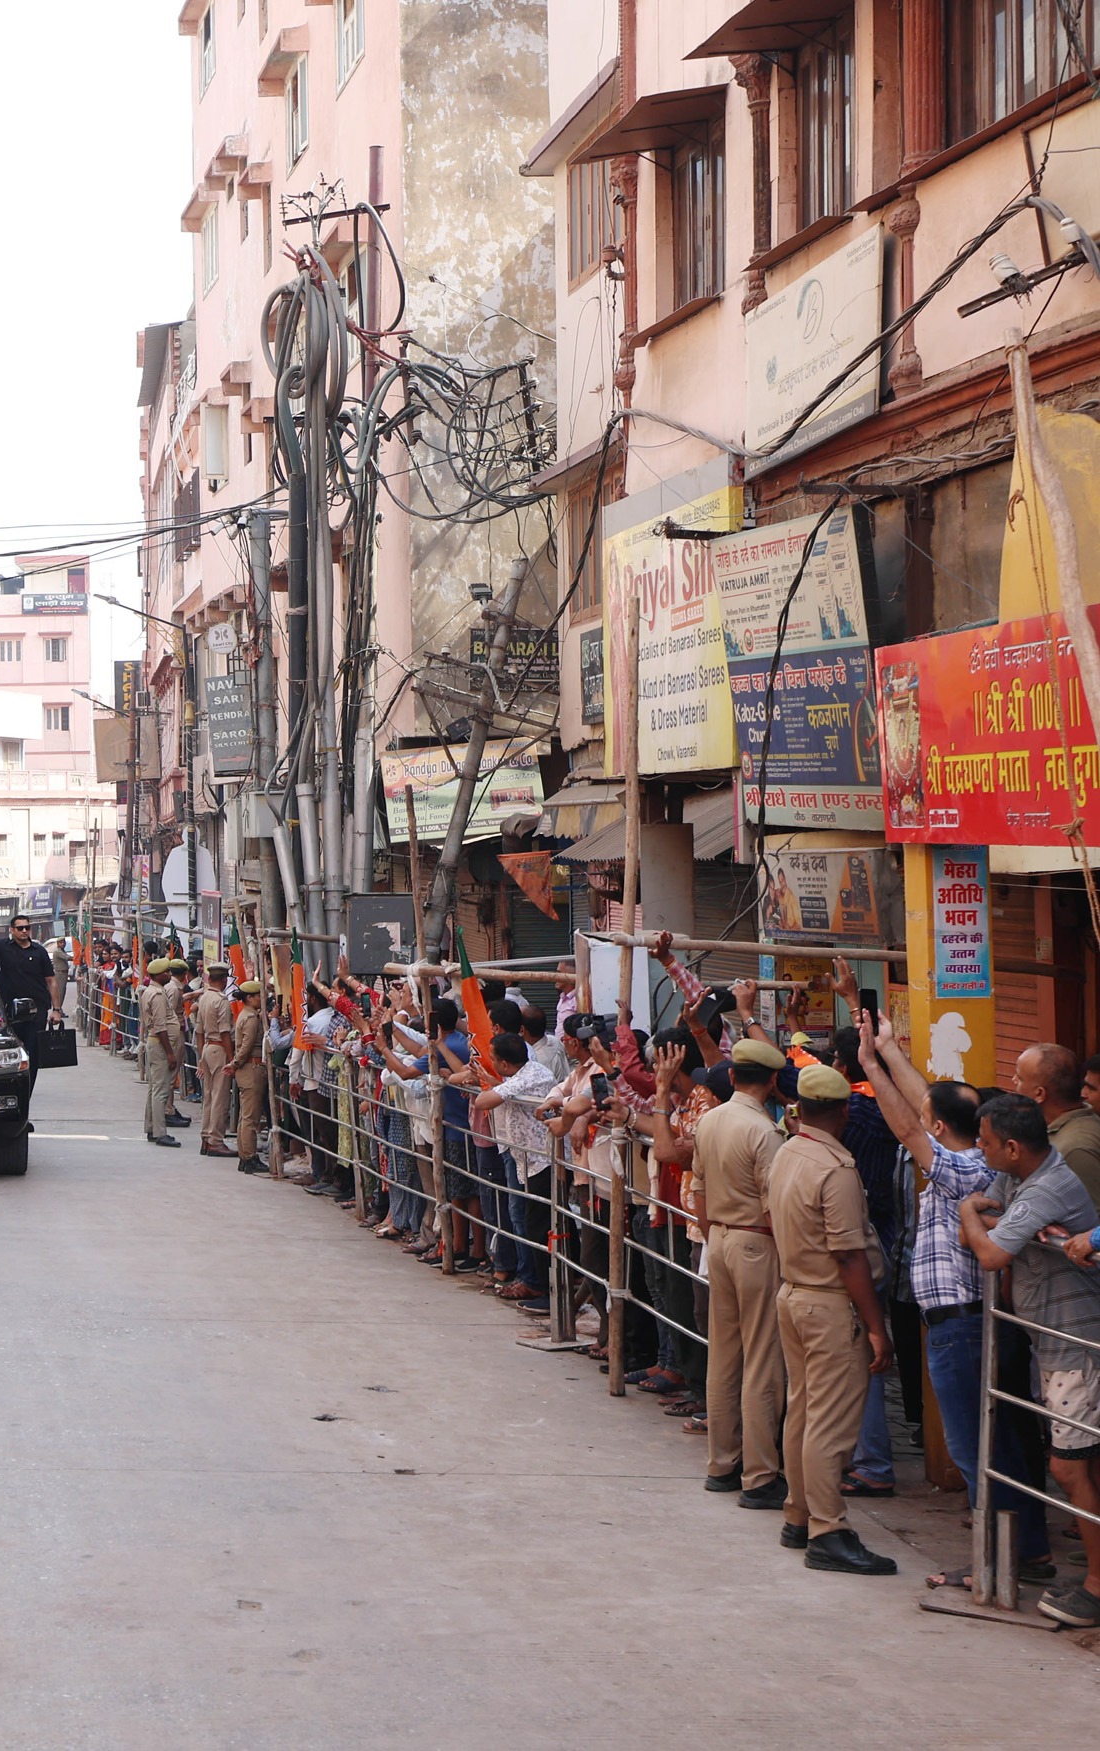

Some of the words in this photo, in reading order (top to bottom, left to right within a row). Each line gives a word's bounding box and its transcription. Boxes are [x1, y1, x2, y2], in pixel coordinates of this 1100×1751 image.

[750, 545, 759, 562] का
[623, 543, 676, 632] Priyal
[719, 576, 749, 593] VATRUJA
[749, 572, 770, 586] AMRIT
[638, 638, 659, 662] ecialist
[660, 636, 668, 655] of
[669, 630, 696, 654] Banarasi
[698, 626, 722, 646] Sarees
[206, 679, 242, 693] NAV
[643, 677, 658, 699] Kind
[659, 673, 667, 695] of
[667, 666, 697, 695] Banarasi
[698, 665, 725, 689] Sarees
[730, 674, 751, 694] कब्ज
[752, 672, 765, 692] का
[784, 662, 806, 690] बिना
[834, 657, 847, 685] के
[210, 710, 251, 721] KENDRA
[651, 709, 657, 732] &
[658, 705, 678, 730] Dress
[678, 699, 708, 727] Material
[733, 701, 781, 724] Kabz-Gne
[985, 680, 1004, 735] श्री
[1007, 677, 1026, 732] श्री
[676, 742, 698, 759] Varanasi
[403, 762, 437, 779] Pandya
[926, 744, 942, 796] श्री
[996, 749, 1031, 793] माता
[1043, 747, 1069, 791] नव
[765, 787, 787, 808] राधे
[789, 792, 817, 809] लाल
[821, 792, 851, 810] एण्ड
[943, 858, 978, 879] मेहरा
[937, 883, 984, 904] अतिथि
[944, 909, 978, 926] भवन
[941, 932, 968, 944] ठहरने
[970, 932, 983, 944] की
[949, 949, 976, 959] उत्तम
[945, 964, 981, 974] व्यवस्था
[941, 981, 960, 990] अन्दर
[962, 981, 977, 990] गली
